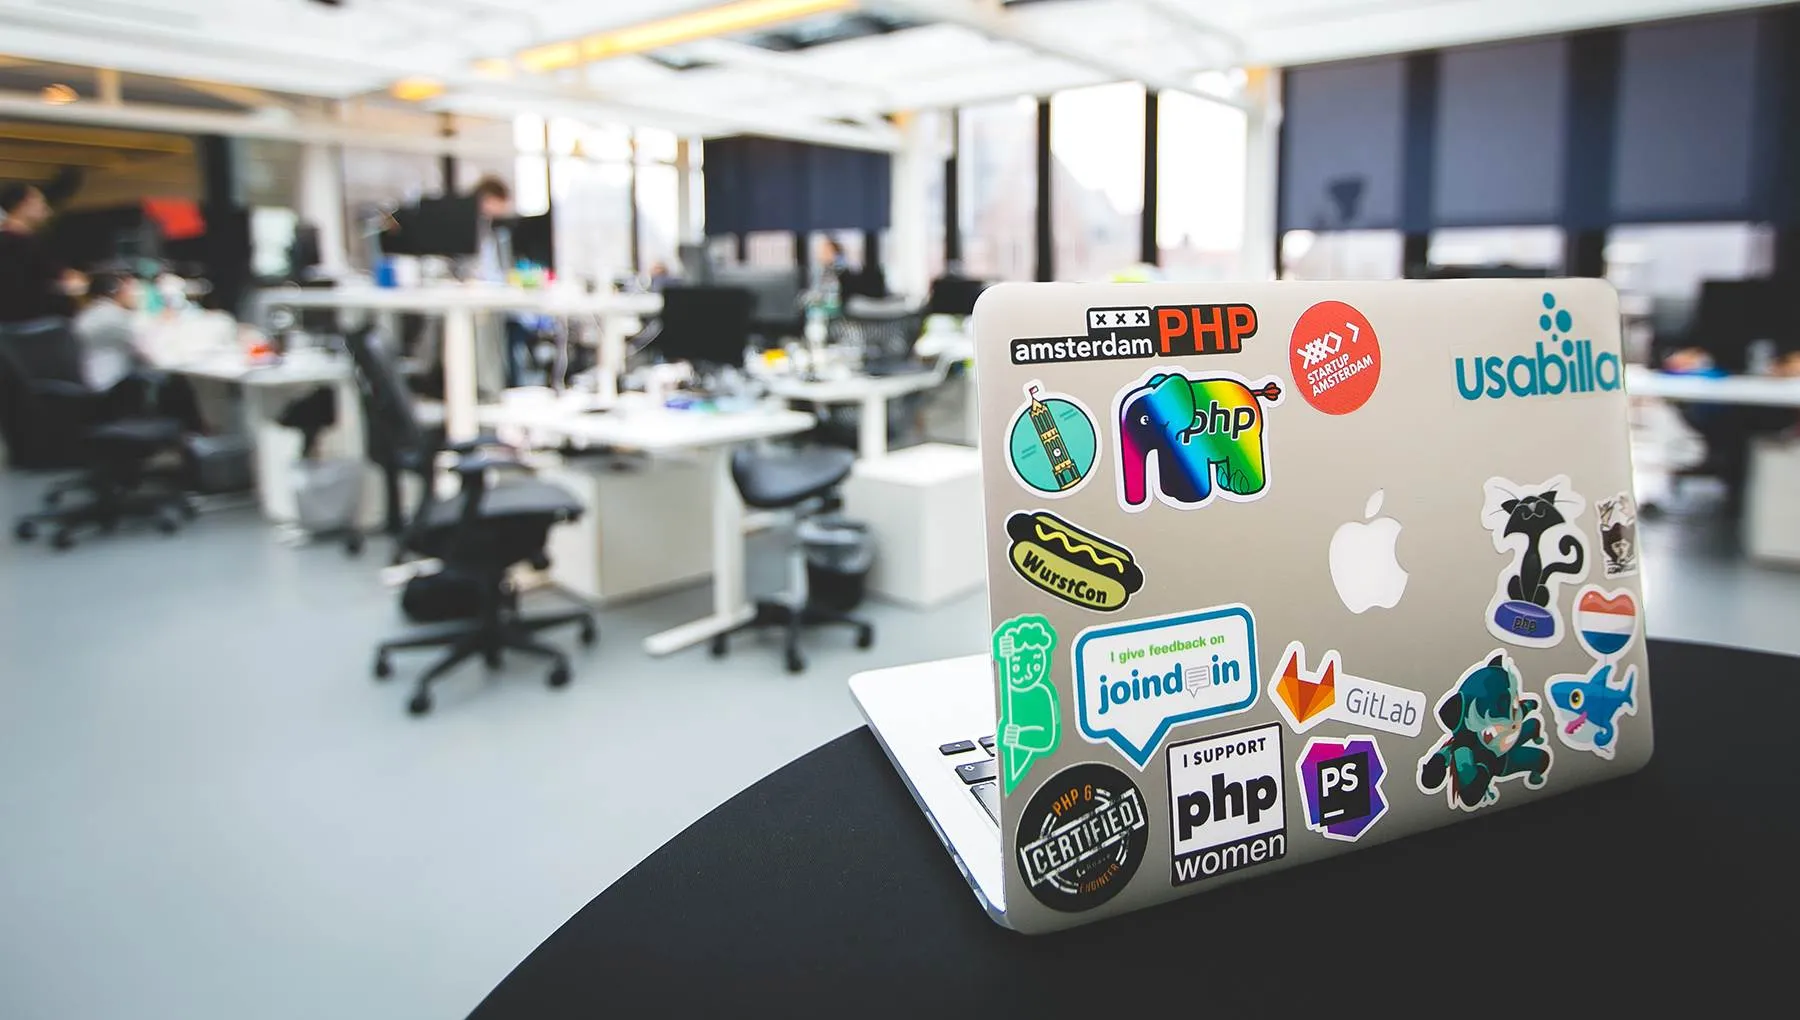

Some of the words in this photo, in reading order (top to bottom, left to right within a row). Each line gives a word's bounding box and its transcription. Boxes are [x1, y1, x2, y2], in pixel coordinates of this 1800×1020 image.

[1014, 332, 1153, 362] amsterdam
[1157, 307, 1255, 353] PHP
[1307, 353, 1350, 385] STARTUP
[1312, 354, 1374, 397] AMSTERDAM
[1455, 339, 1621, 401] usabilla
[1182, 400, 1256, 445] php
[1022, 550, 1107, 604] WurstCon
[1512, 613, 1537, 633] php
[1110, 651, 1115, 662] I
[1118, 648, 1145, 664] give
[1149, 636, 1206, 656] feedback
[1210, 635, 1225, 645] on
[1347, 688, 1416, 726] GitLab
[1183, 754, 1188, 768] I
[1193, 737, 1267, 766] SUPPORT
[1321, 763, 1359, 797] PS
[1052, 788, 1079, 817] PHP
[1176, 773, 1278, 842] php
[1032, 801, 1134, 874] CERTIFIED
[1175, 834, 1286, 882] women
